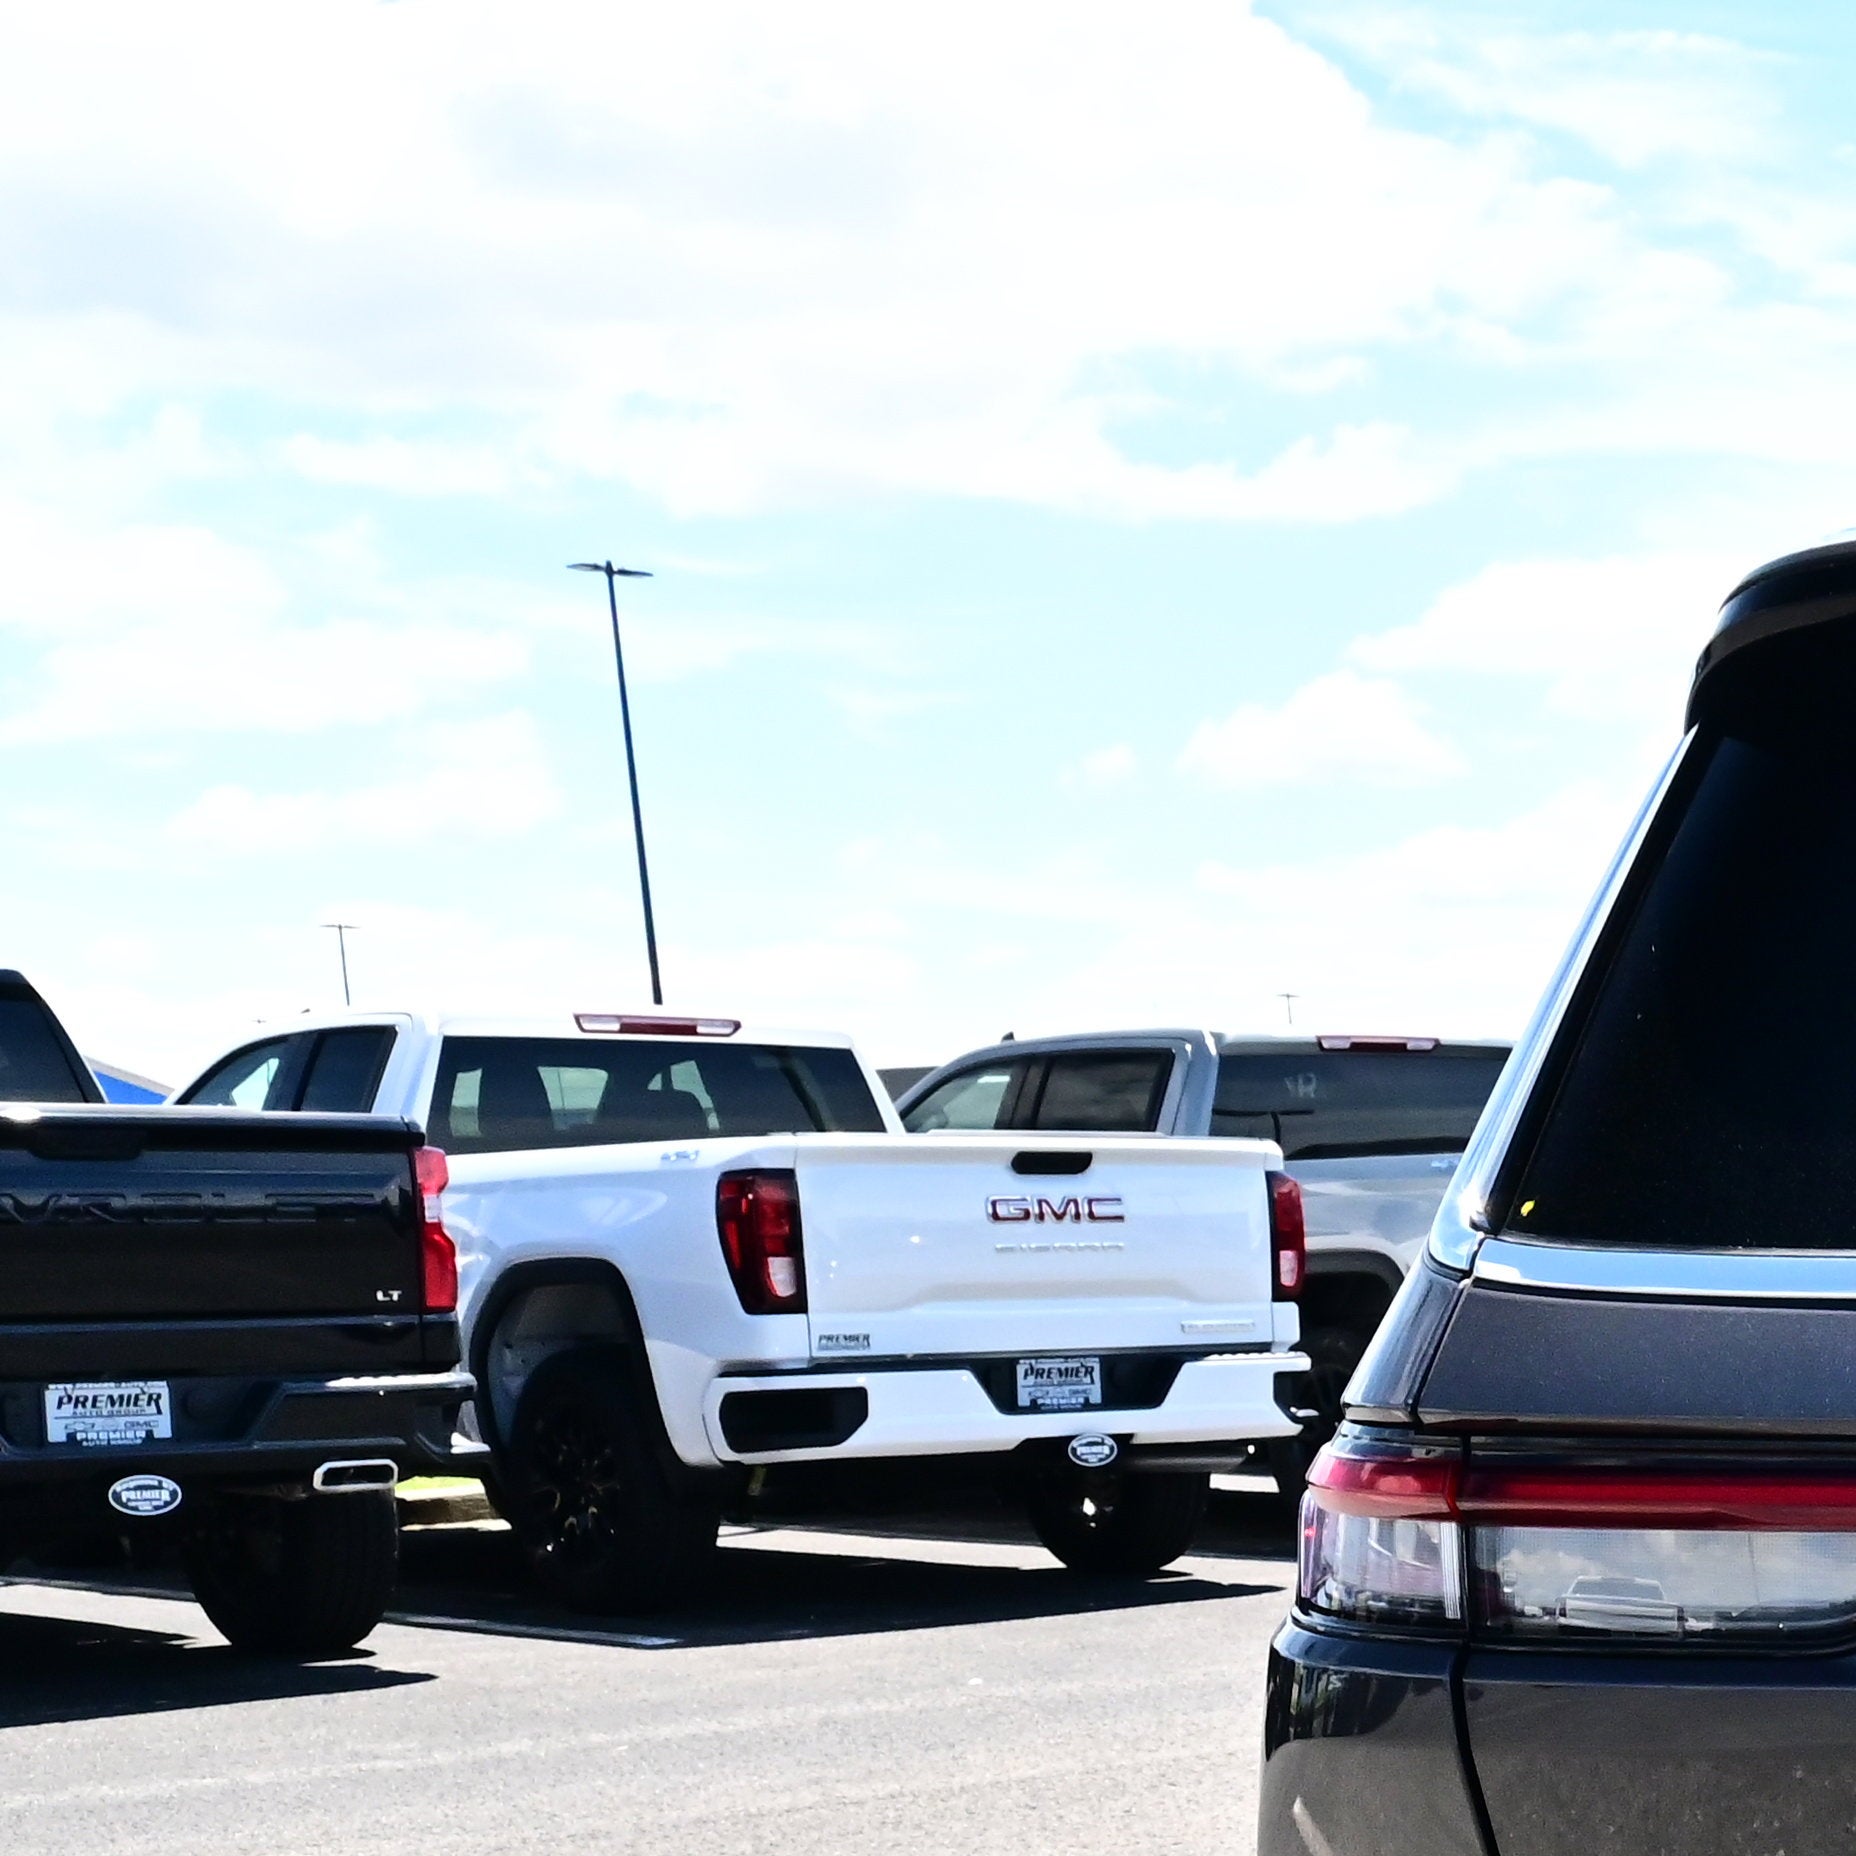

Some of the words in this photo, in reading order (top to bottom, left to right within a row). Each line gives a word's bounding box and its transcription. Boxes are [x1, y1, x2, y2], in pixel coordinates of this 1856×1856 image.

[986, 1195, 1125, 1224] GMC
[375, 1289, 403, 1302] LT
[1023, 1365, 1095, 1383] PREMIER
[57, 1392, 162, 1413] PREMIER
[76, 1430, 146, 1441] PREMIER
